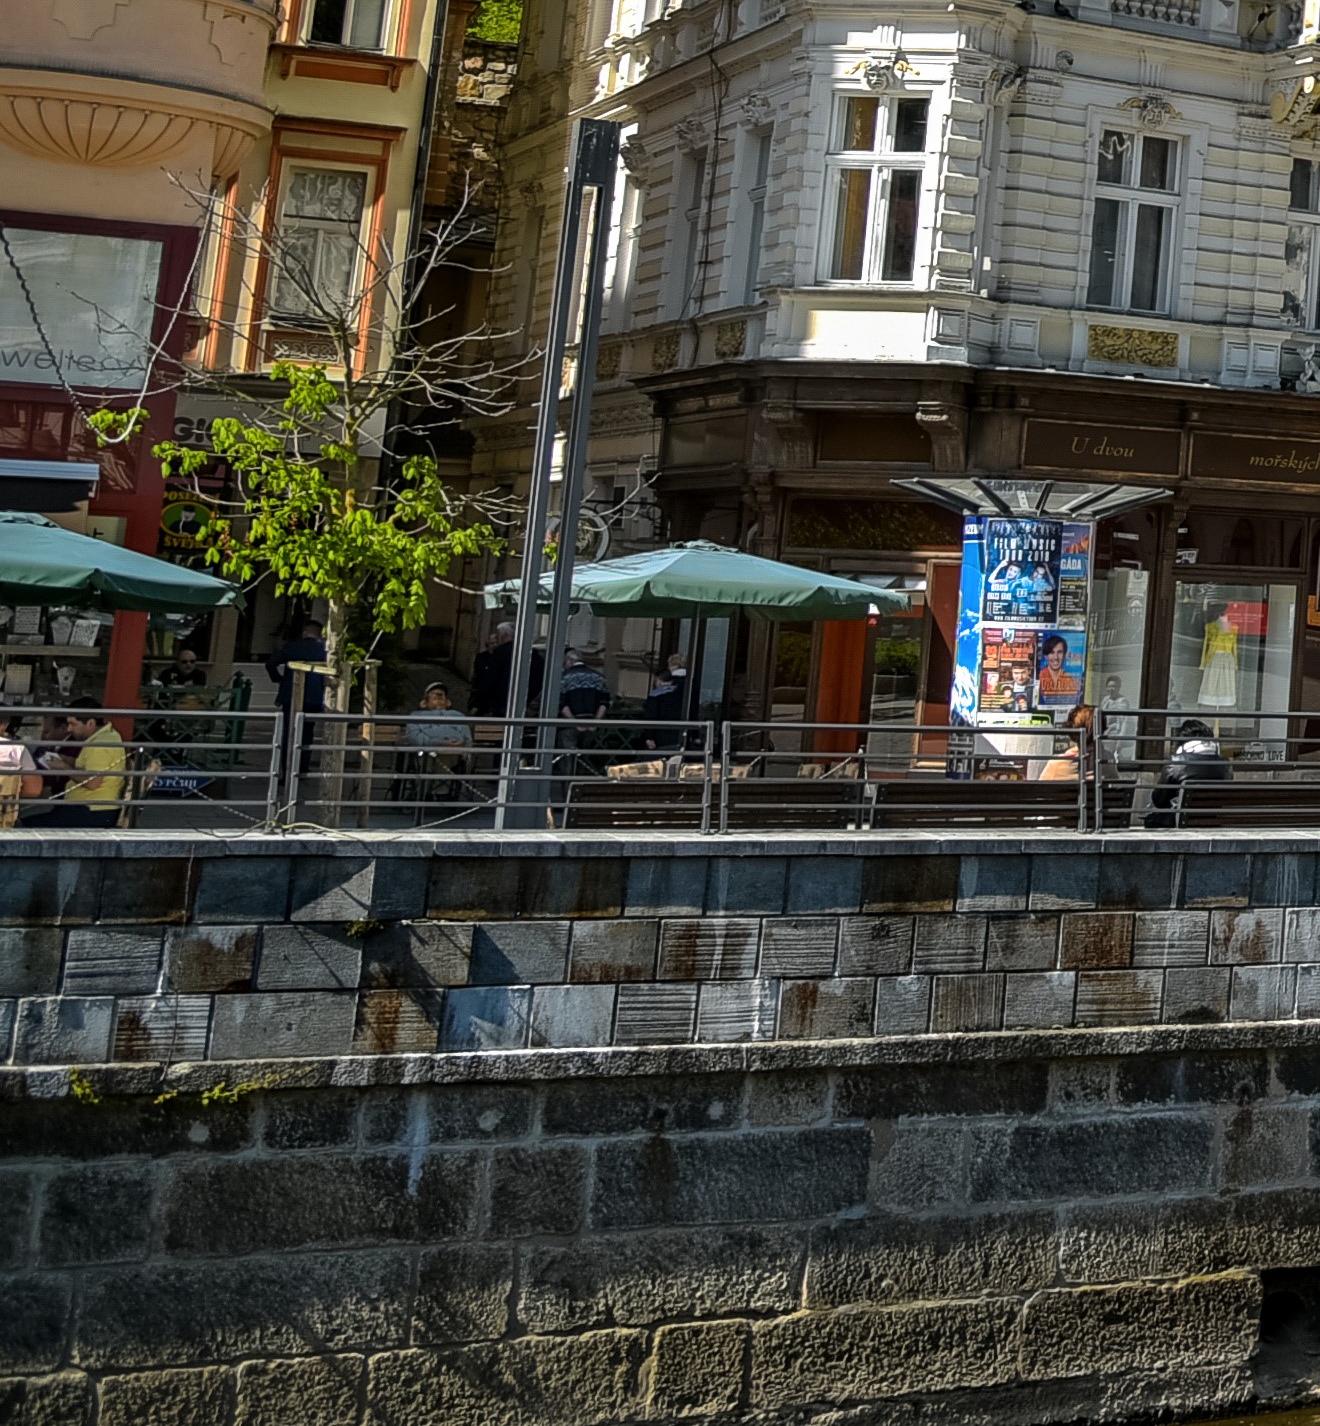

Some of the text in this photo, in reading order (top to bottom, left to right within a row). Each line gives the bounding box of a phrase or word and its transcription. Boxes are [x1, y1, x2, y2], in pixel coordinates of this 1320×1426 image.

[1070, 436, 1135, 458] U dvou
[1267, 749, 1284, 762] LOVE
